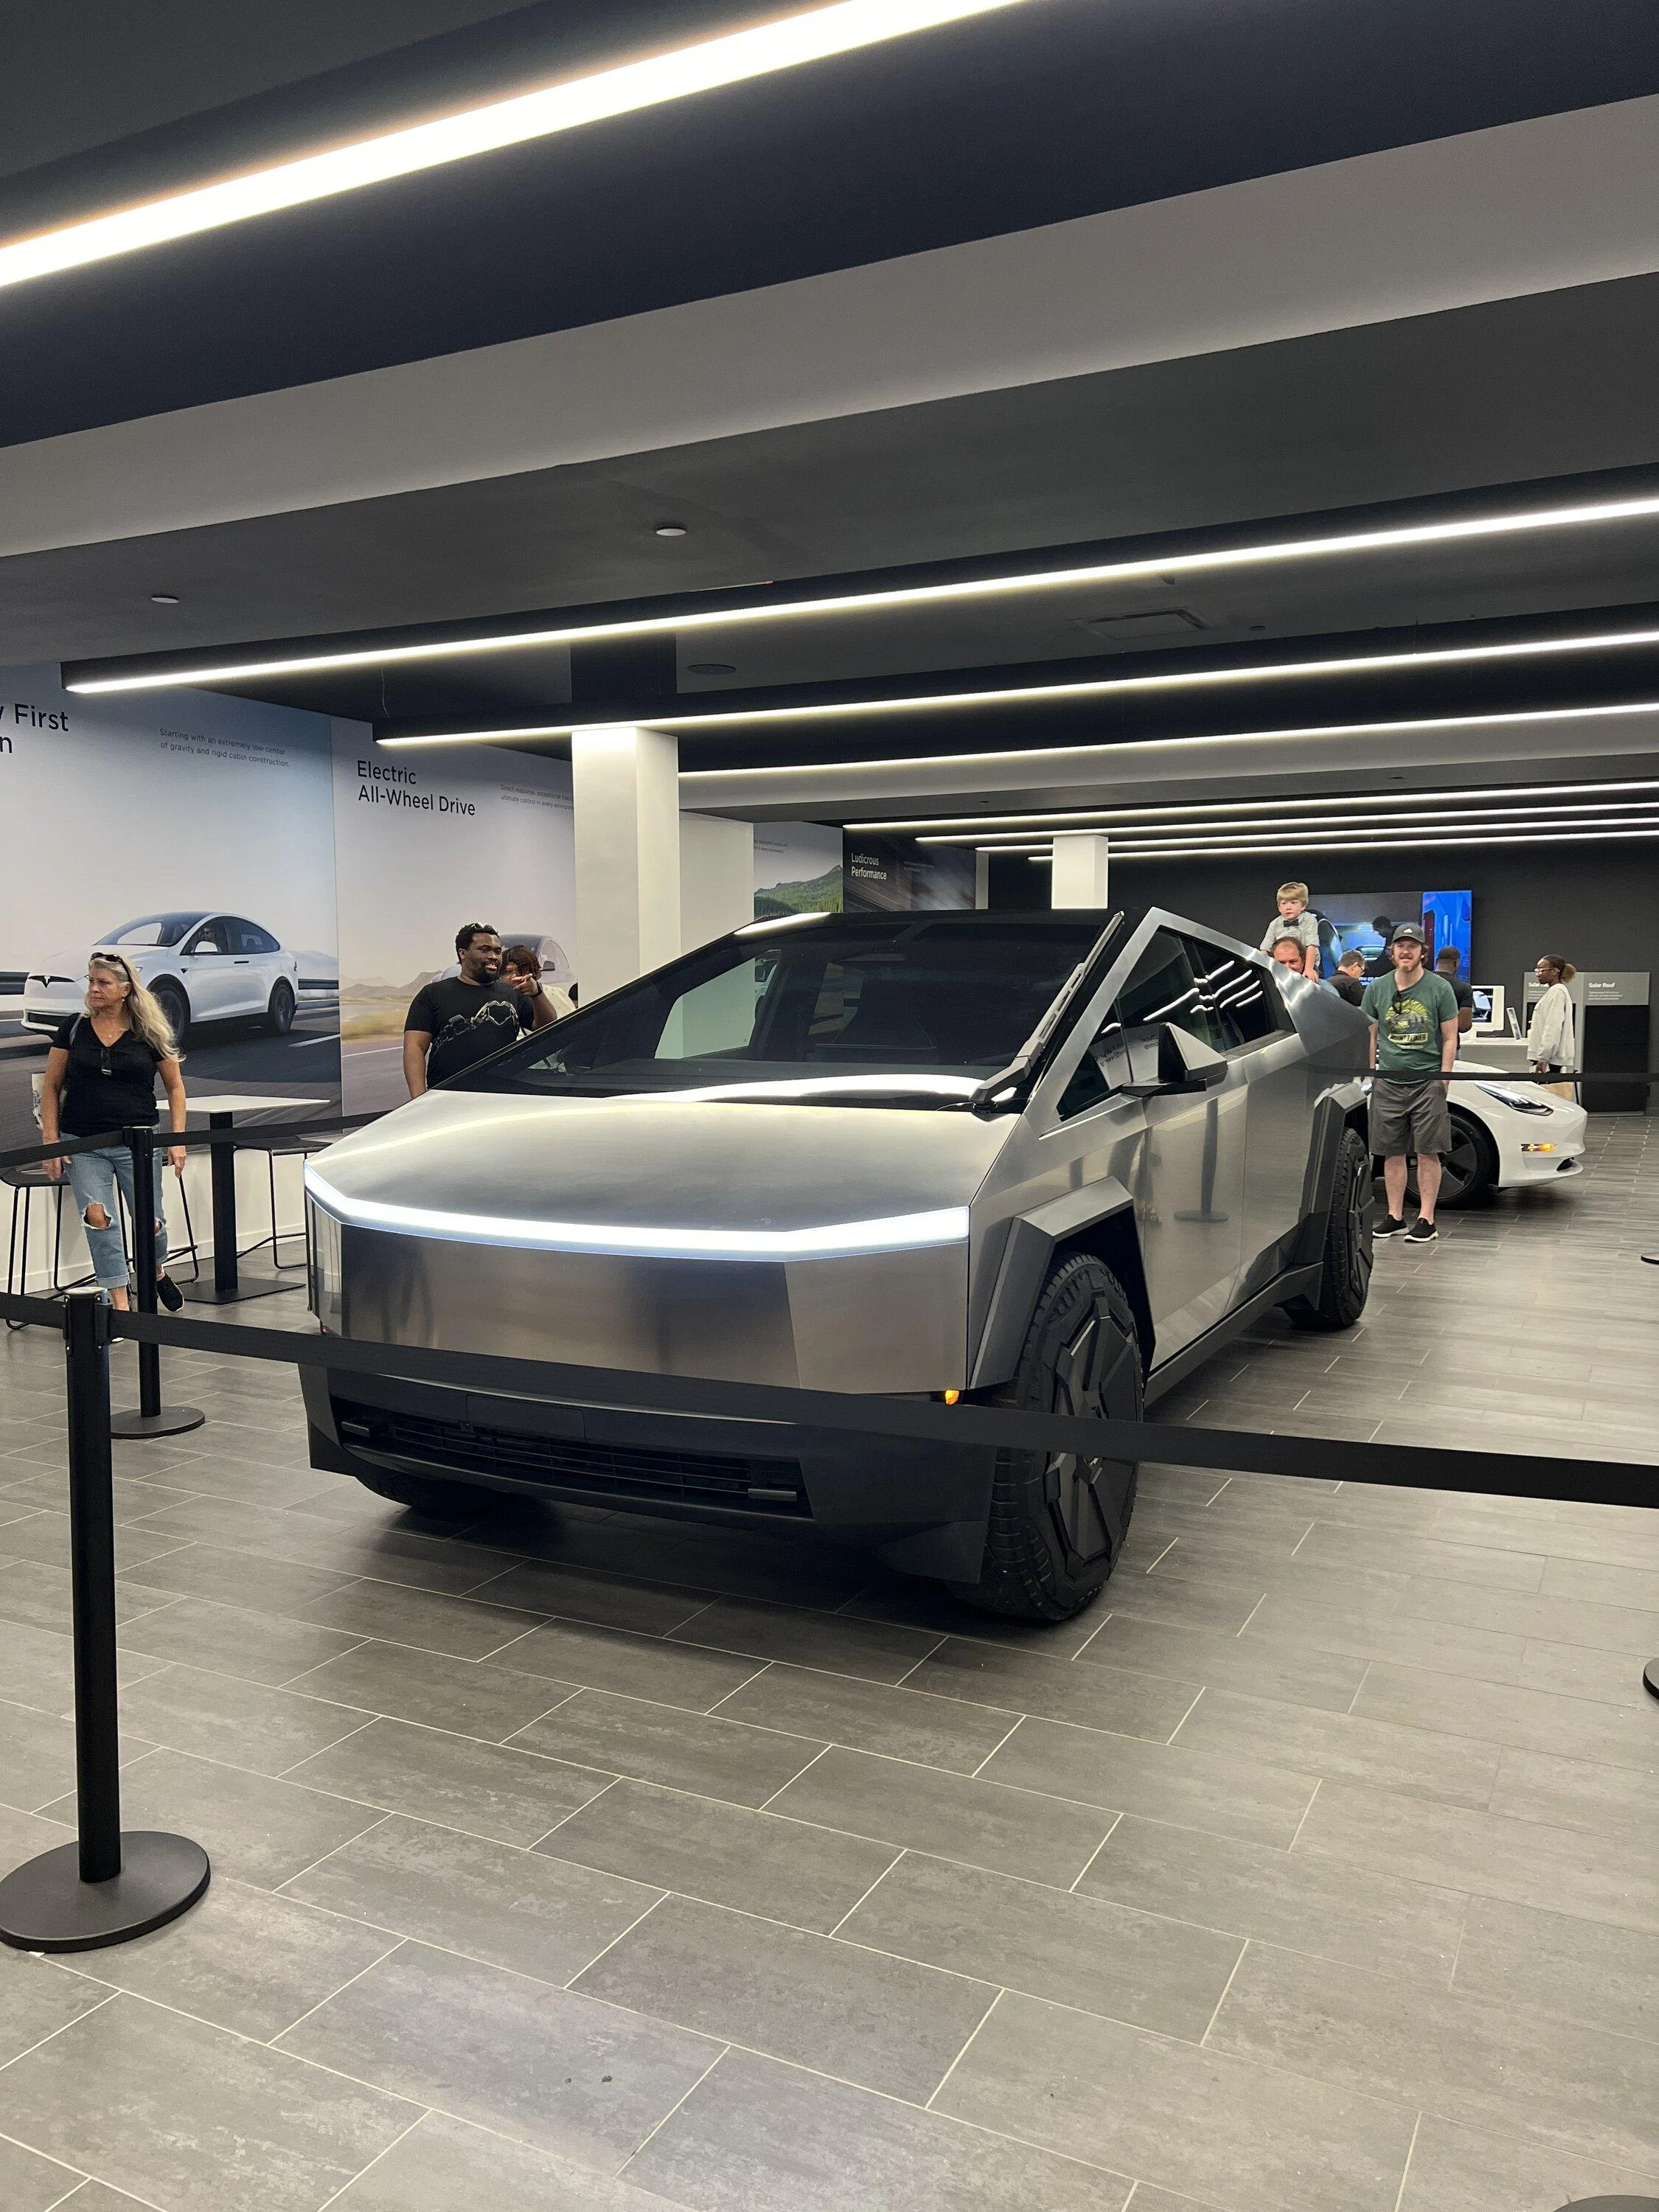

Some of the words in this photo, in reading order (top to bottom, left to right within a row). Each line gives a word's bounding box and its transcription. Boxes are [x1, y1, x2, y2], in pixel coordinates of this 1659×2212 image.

[15, 703, 69, 731] First
[160, 728, 189, 740] Starting
[190, 734, 206, 742] with
[218, 739, 250, 751] extremely
[252, 743, 263, 751] low
[265, 746, 285, 755] center
[170, 743, 194, 754] gravity
[212, 750, 227, 758] rigid
[229, 752, 247, 761] cabin
[358, 760, 417, 785] Electric
[358, 785, 434, 810] All-Wheel
[439, 796, 476, 815] Drive
[852, 852, 880, 866] Ludicrous
[852, 866, 887, 880] Performance
